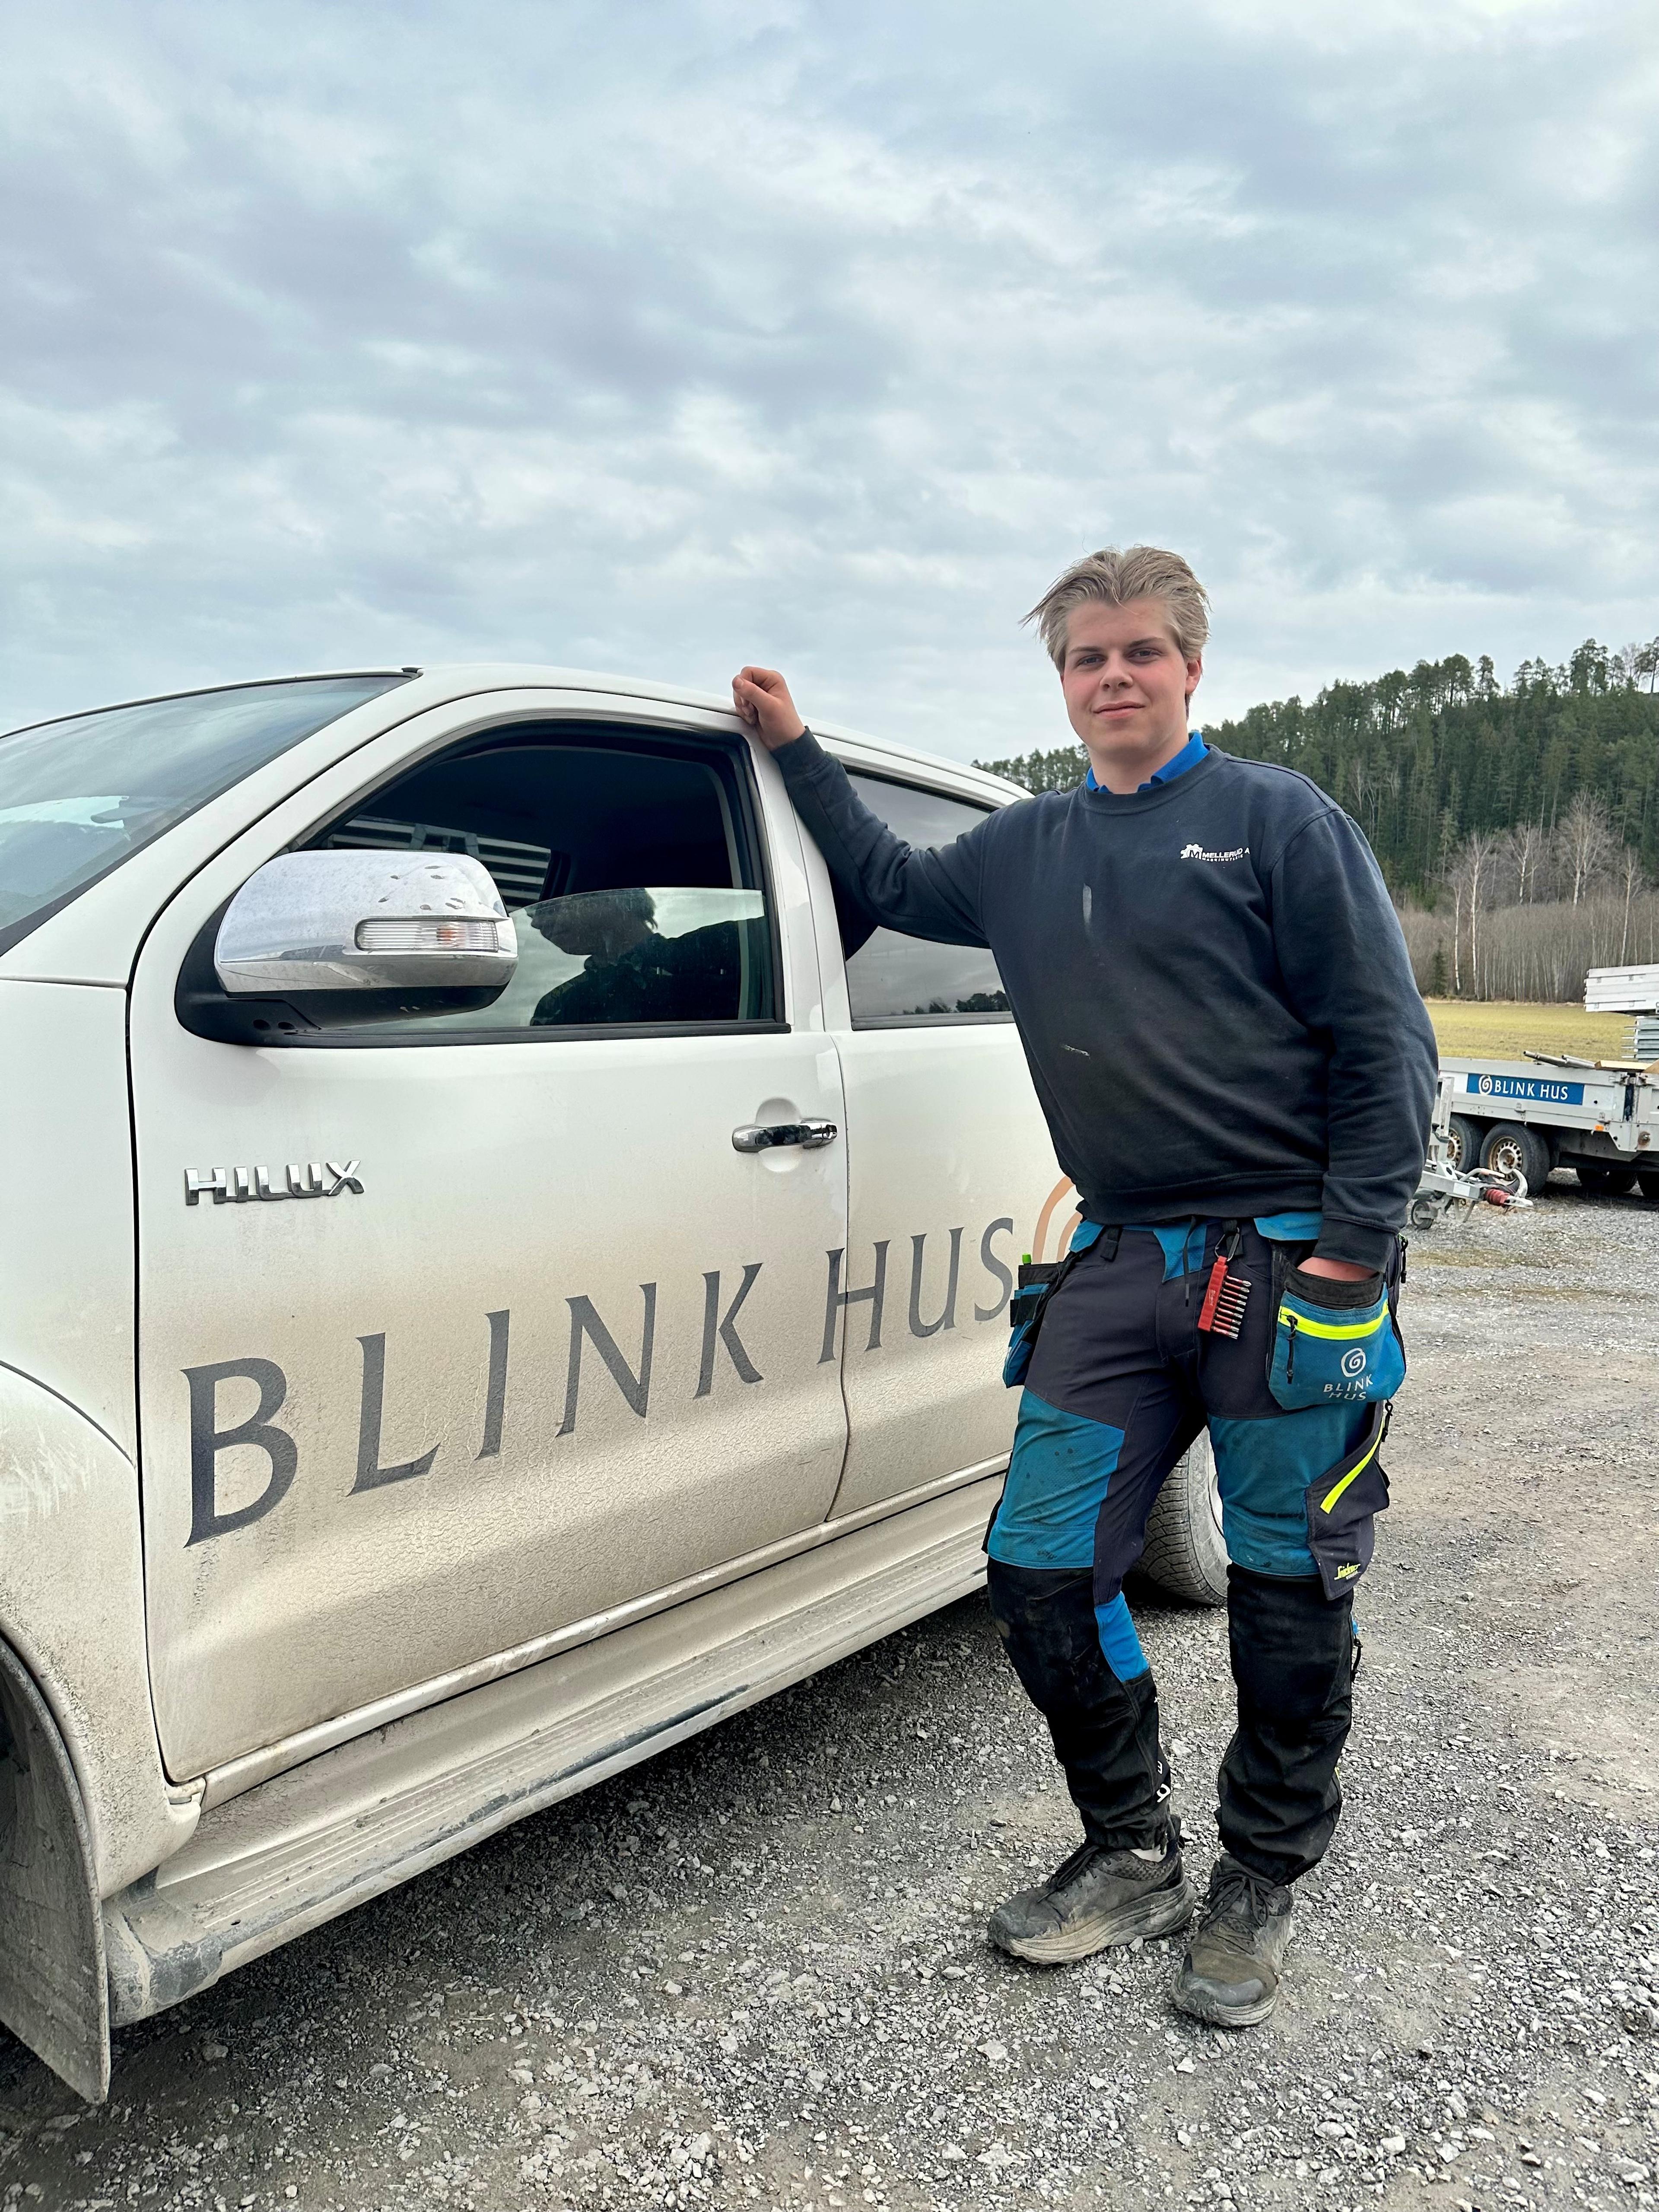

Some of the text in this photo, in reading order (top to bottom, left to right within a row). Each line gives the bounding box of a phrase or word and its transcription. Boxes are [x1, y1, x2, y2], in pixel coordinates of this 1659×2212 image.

[1202, 848, 1243, 858] MELLERUD
[1494, 1080, 1568, 1100] BLINK HUS
[185, 1160, 364, 1205] HILUX
[180, 1217, 1013, 1548] BLINK HUS
[1323, 1373, 1373, 1392] BLINK
[1328, 1392, 1367, 1401] HUS
